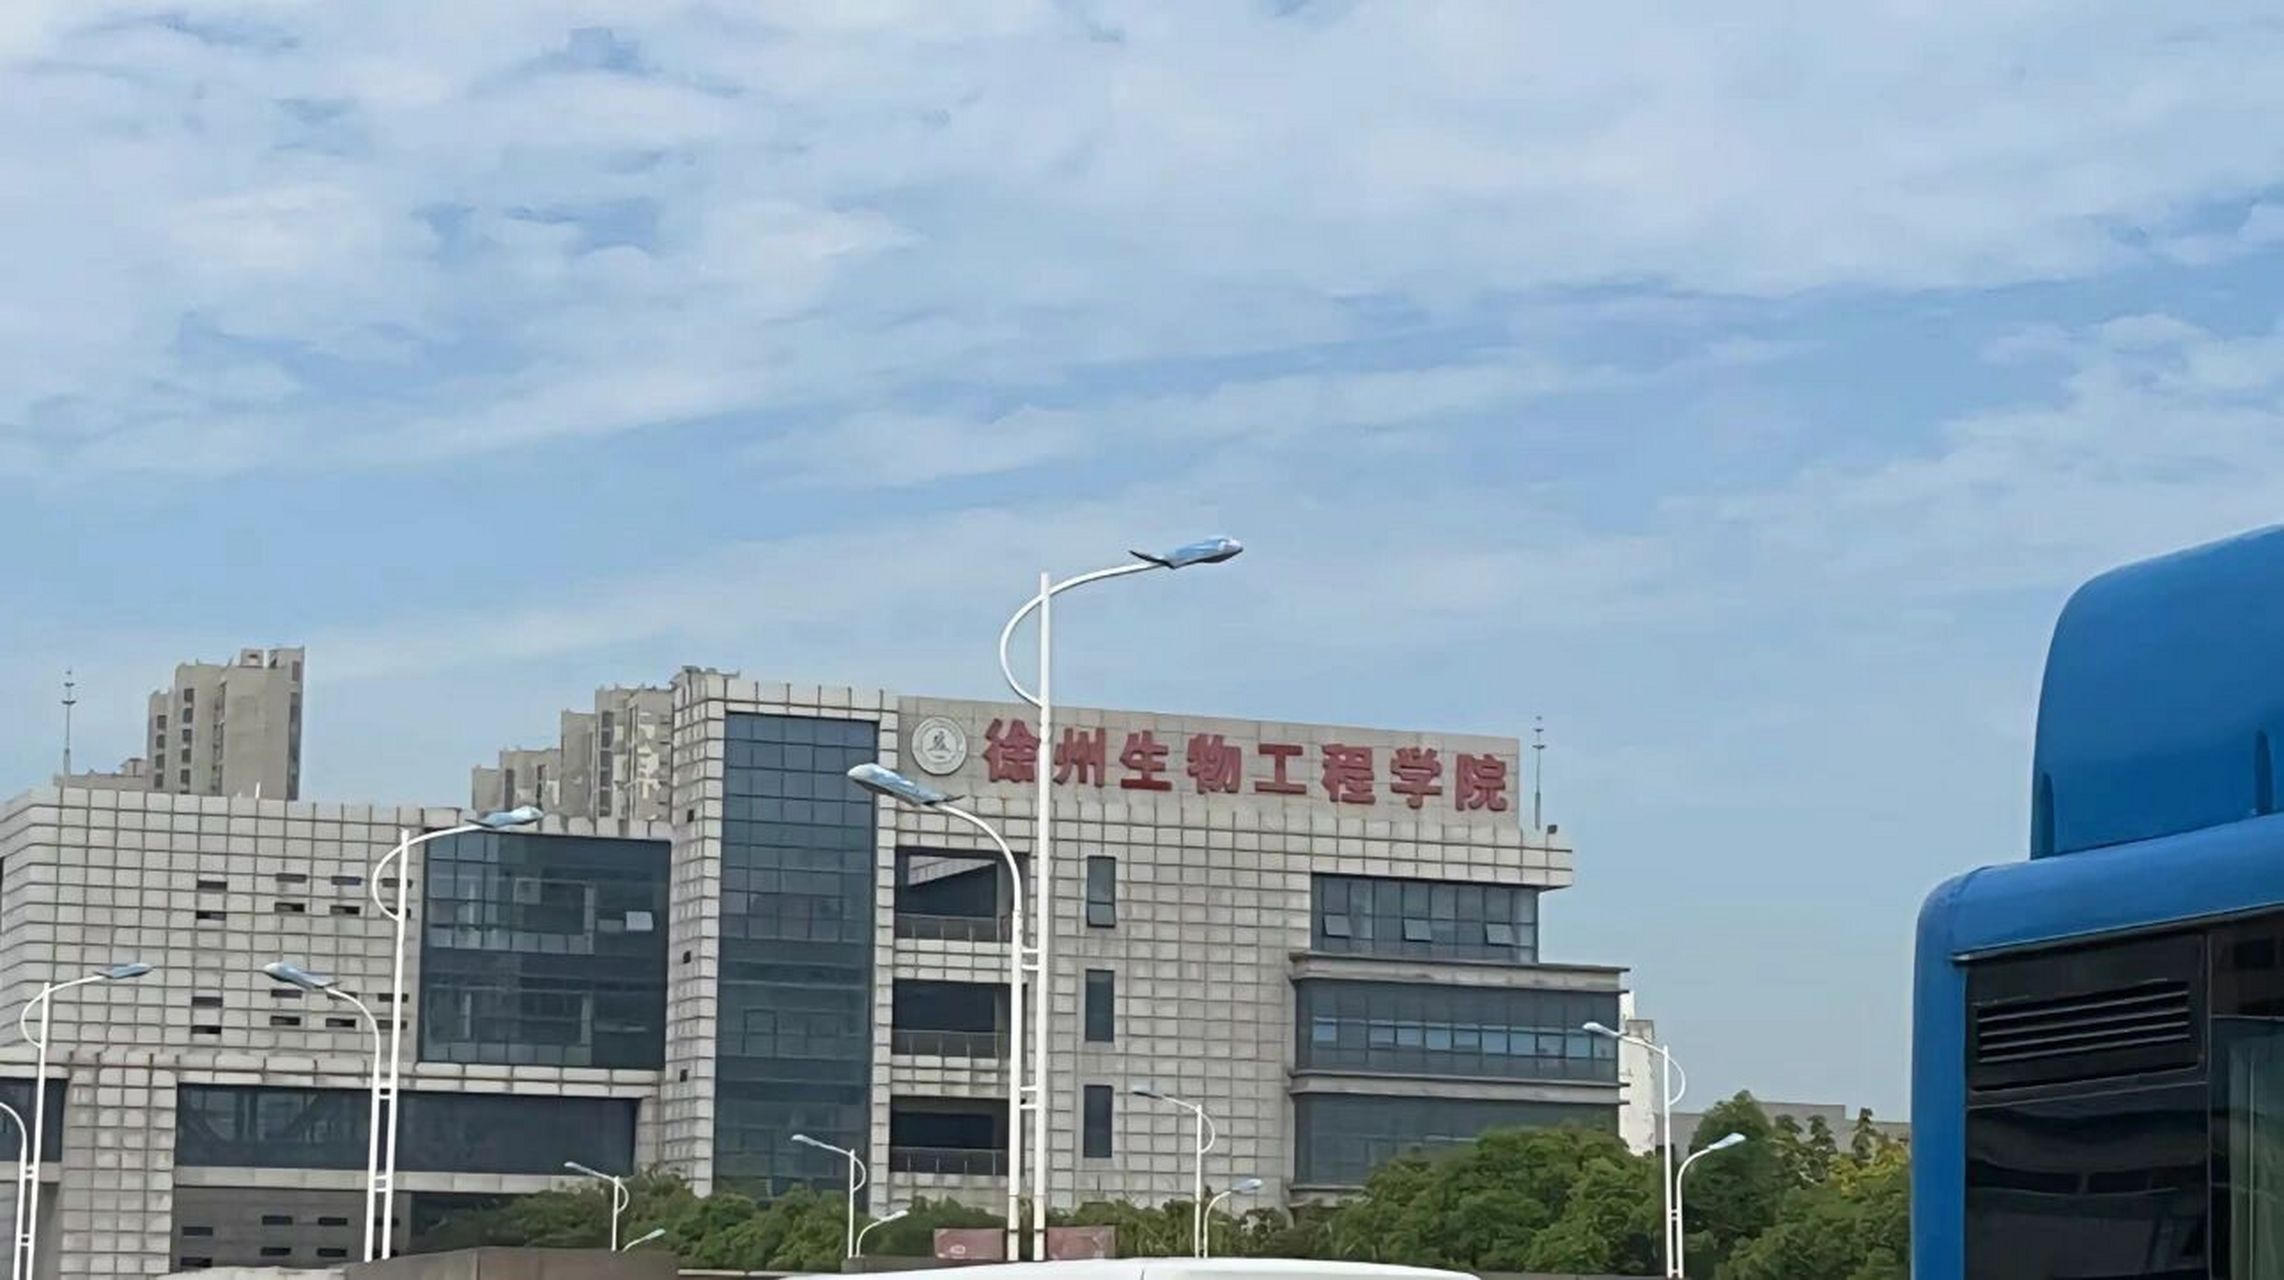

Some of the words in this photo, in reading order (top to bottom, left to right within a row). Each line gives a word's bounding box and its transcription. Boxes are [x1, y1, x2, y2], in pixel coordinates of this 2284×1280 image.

[983, 718, 1508, 811] 徐州生物工程学院
